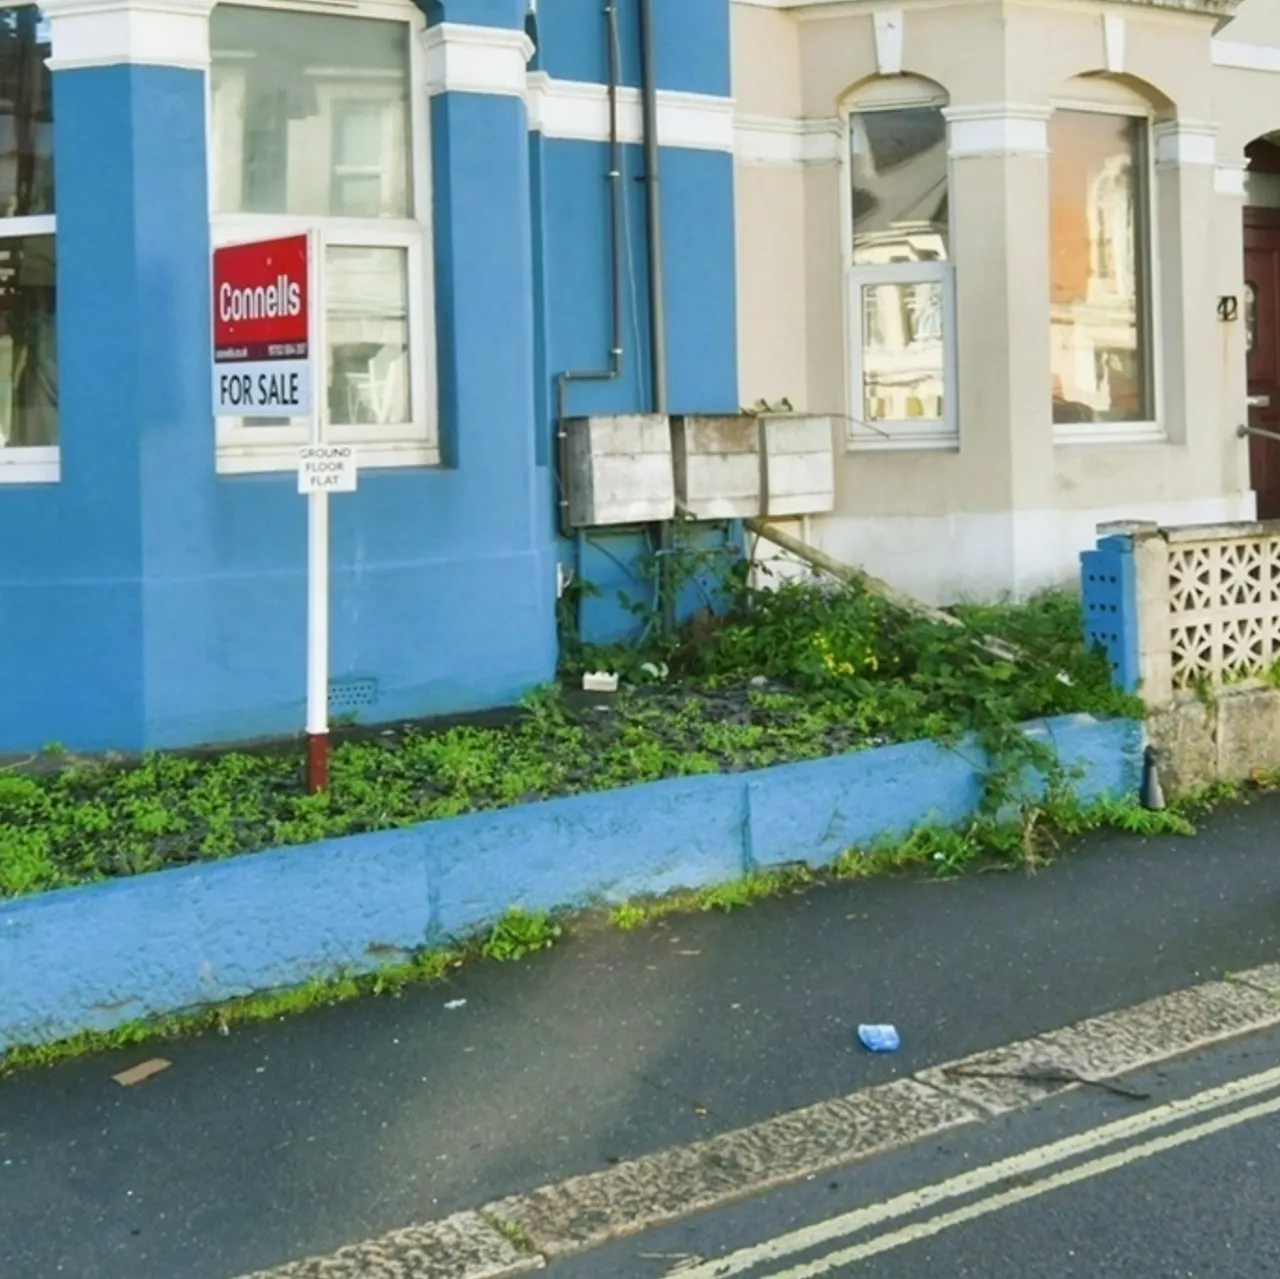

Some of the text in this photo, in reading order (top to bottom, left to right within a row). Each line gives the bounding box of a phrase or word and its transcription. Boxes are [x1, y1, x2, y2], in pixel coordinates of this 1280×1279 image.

[220, 274, 300, 322] Connells
[220, 372, 299, 406] FOR SALE
[300, 447, 351, 459] GROUND
[305, 461, 344, 472] FLOOR
[310, 475, 339, 486] FLAT
